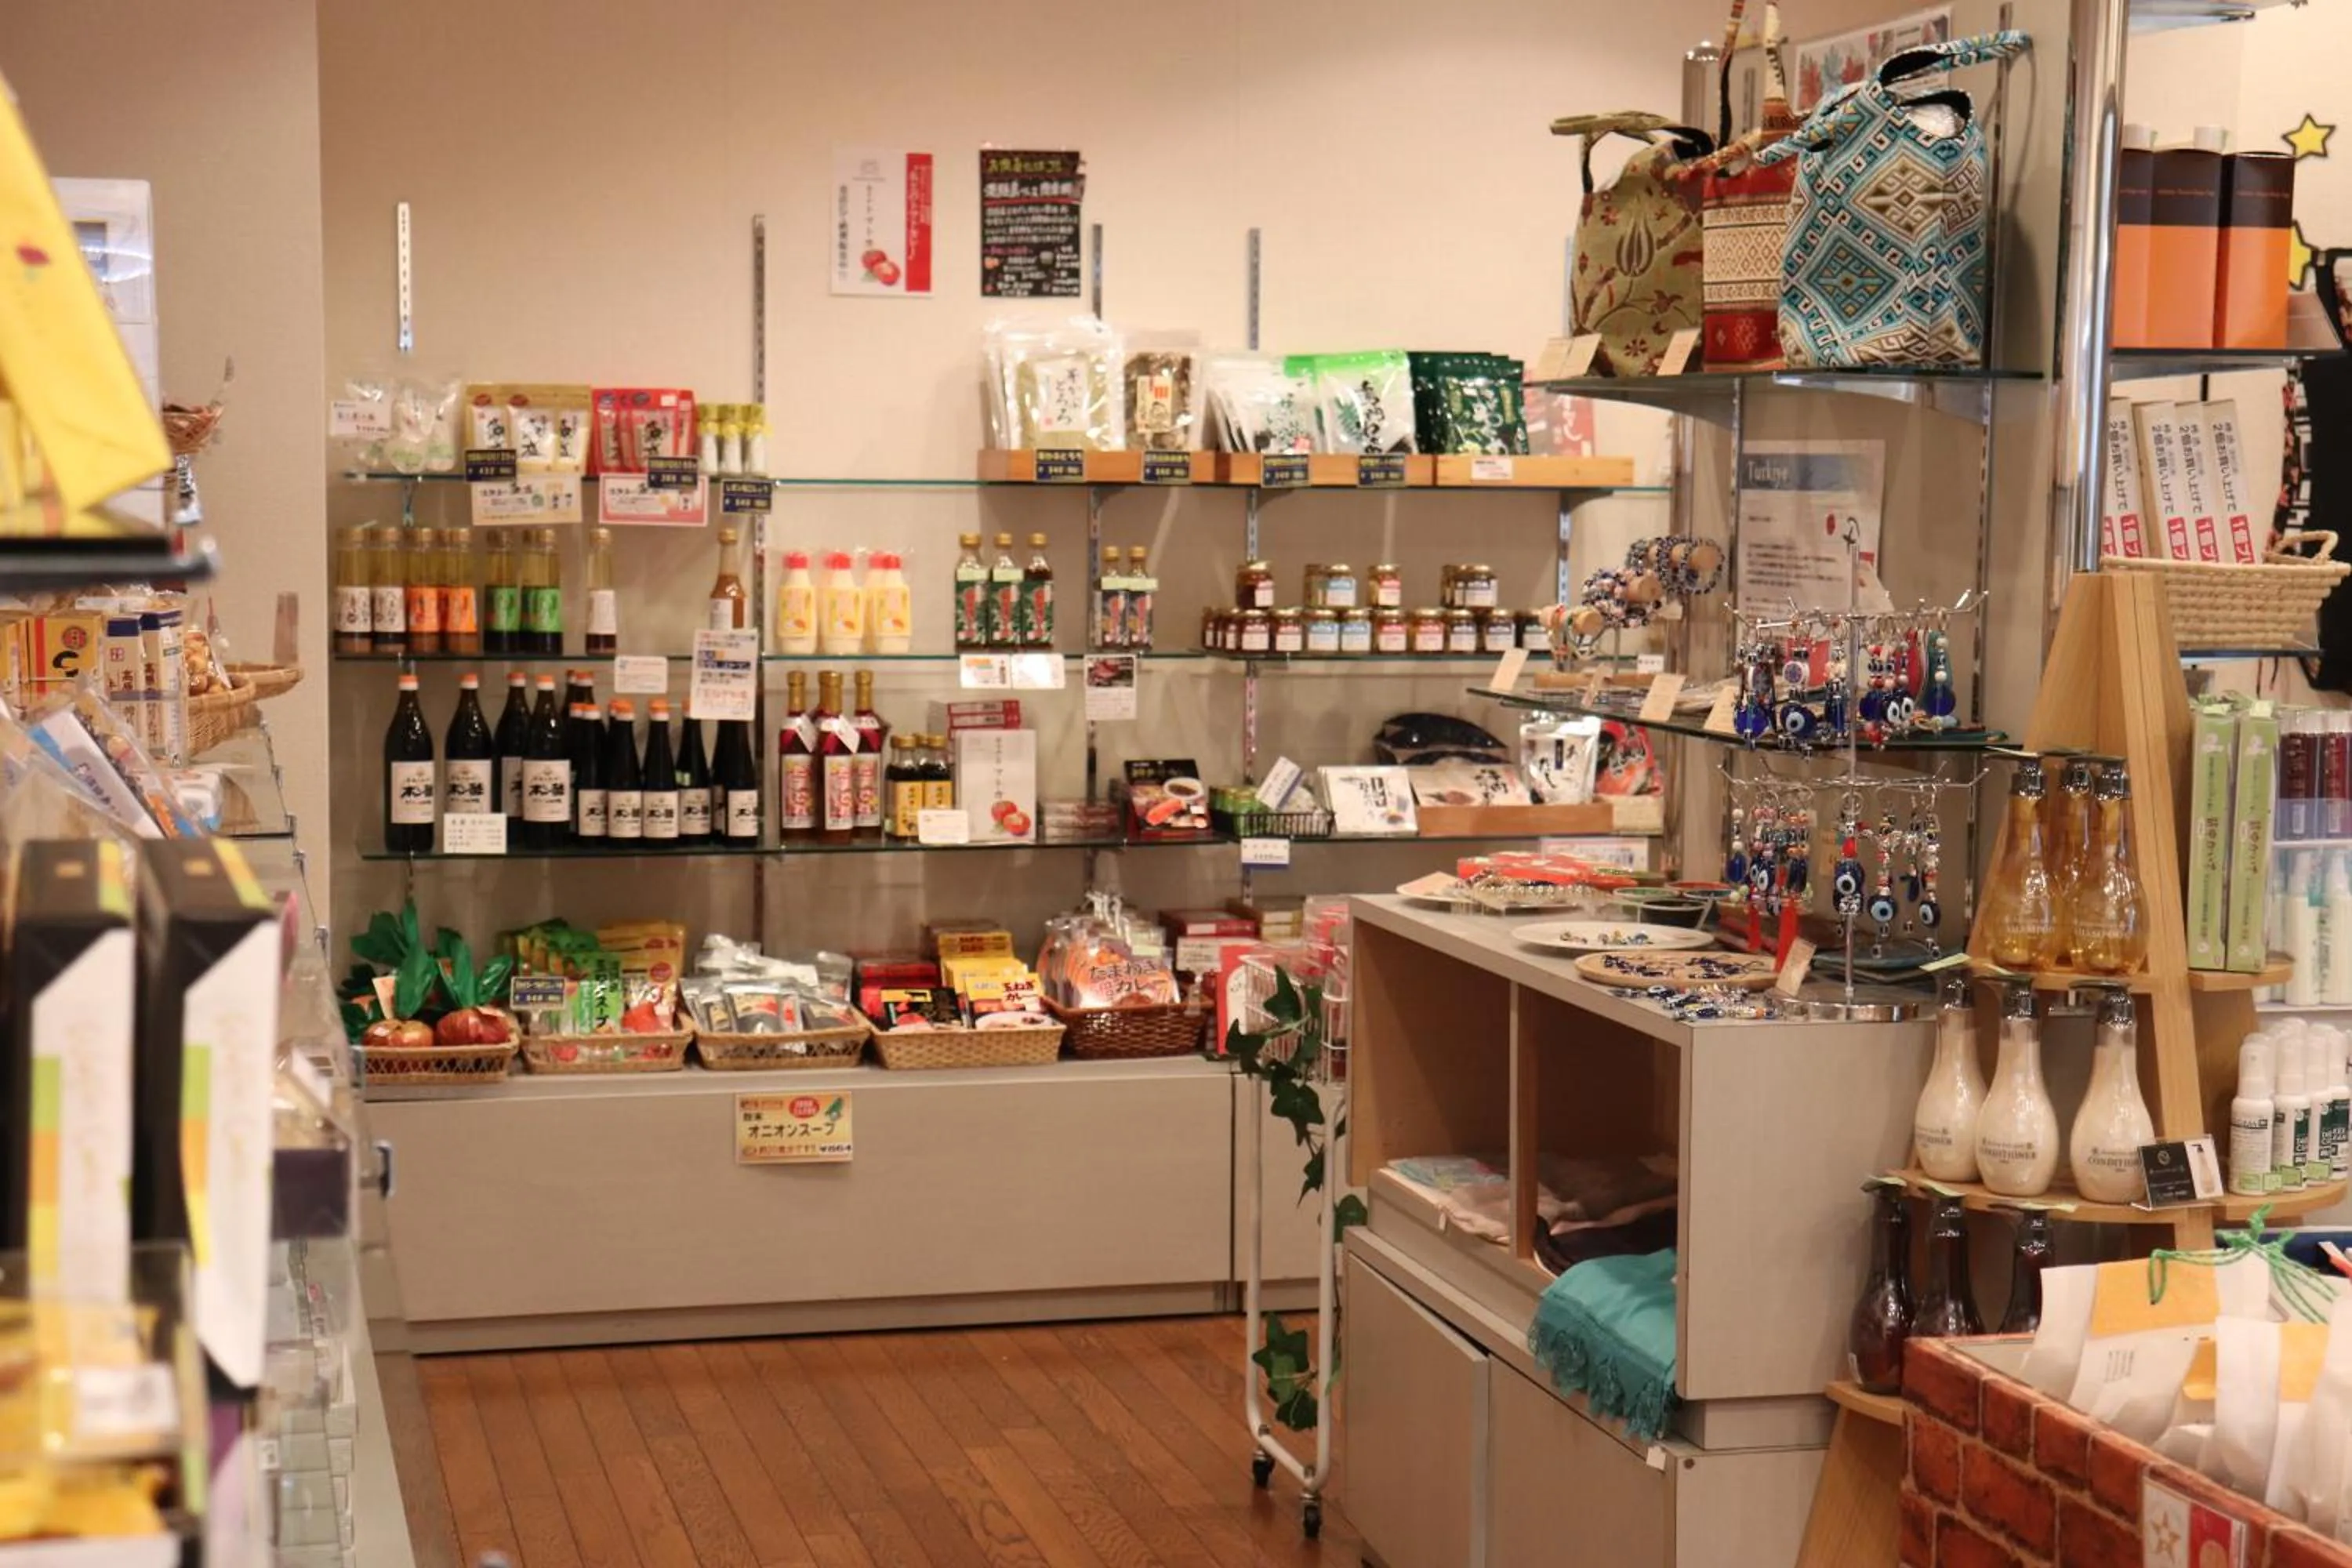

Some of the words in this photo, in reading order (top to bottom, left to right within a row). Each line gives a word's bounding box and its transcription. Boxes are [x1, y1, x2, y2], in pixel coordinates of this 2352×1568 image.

[748, 1122, 835, 1139] オニオンスープ
